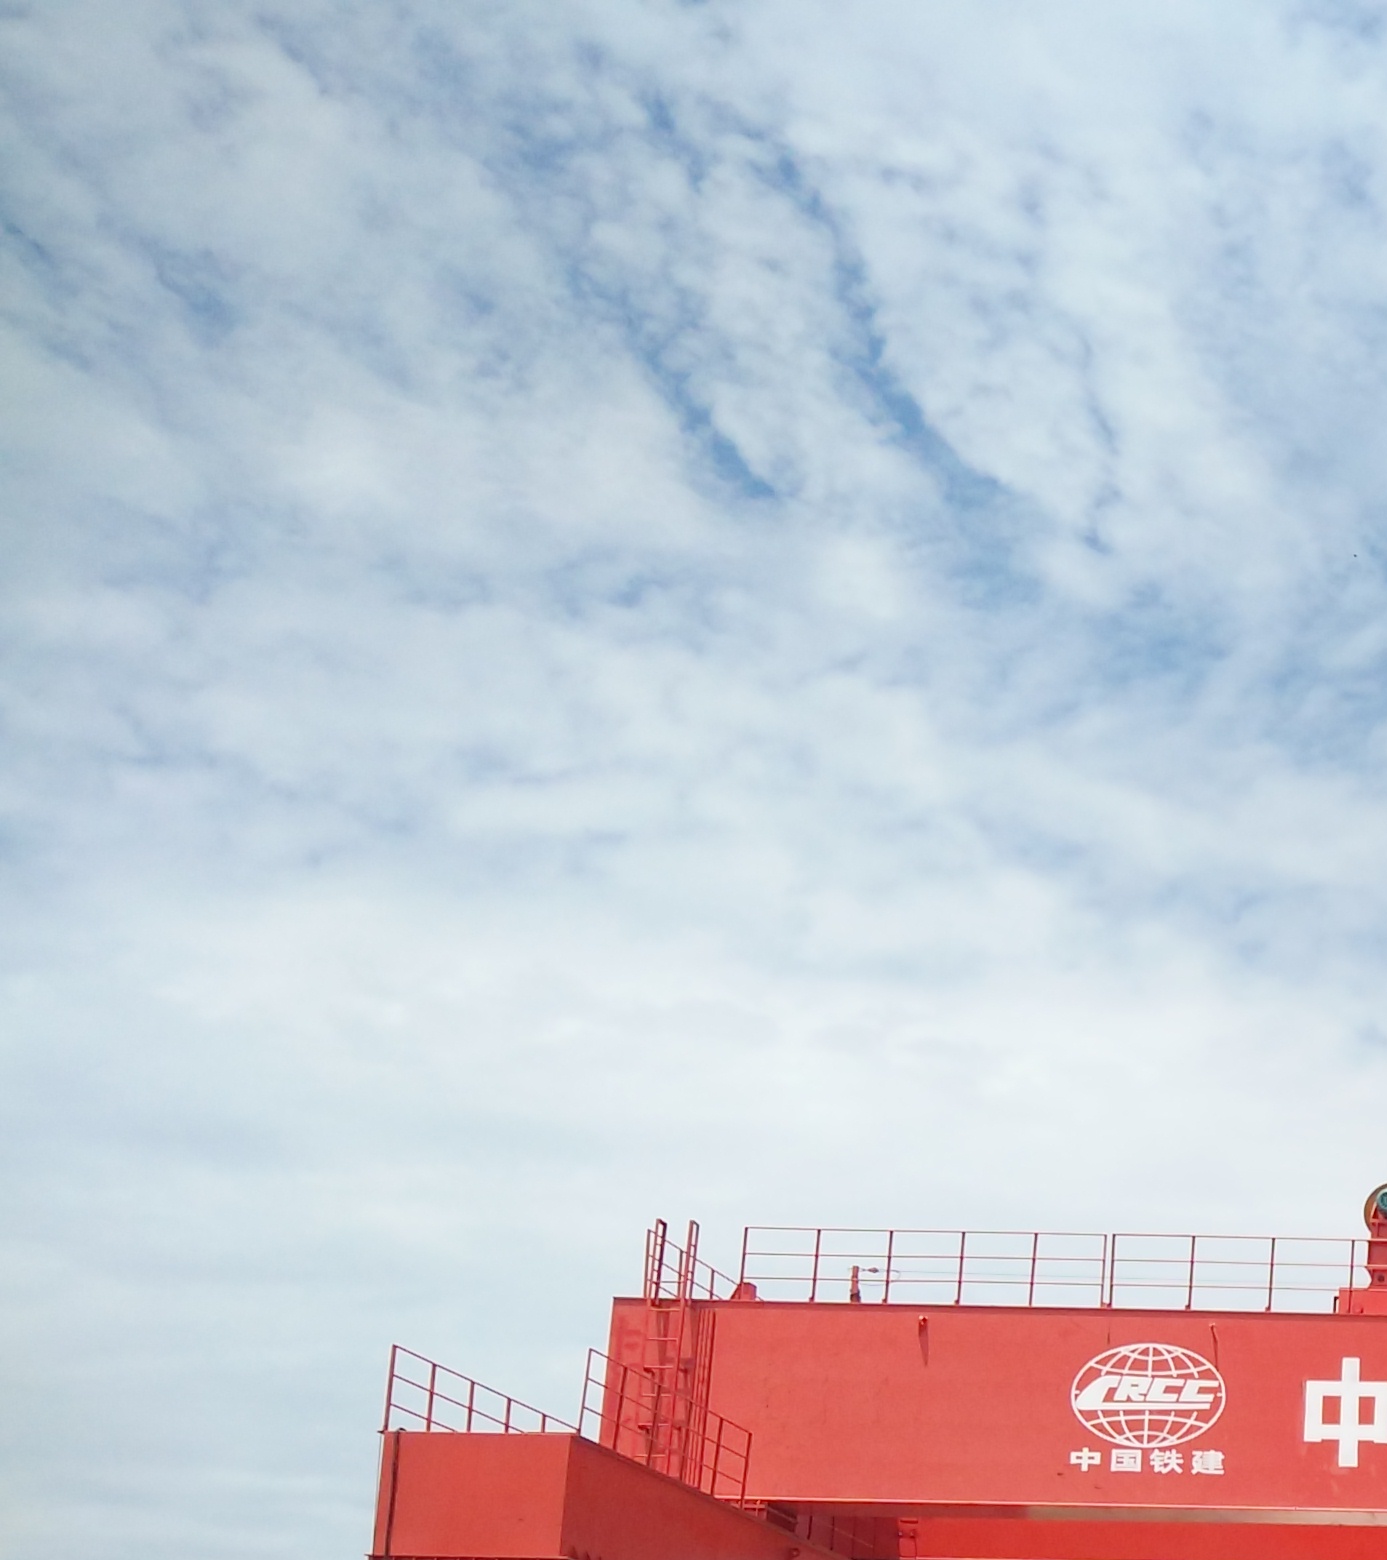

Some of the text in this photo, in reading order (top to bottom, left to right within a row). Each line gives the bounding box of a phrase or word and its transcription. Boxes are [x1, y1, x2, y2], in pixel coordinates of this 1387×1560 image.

[1075, 1375, 1220, 1410] CRCC
[1069, 1447, 1225, 1475] 中国铁建
